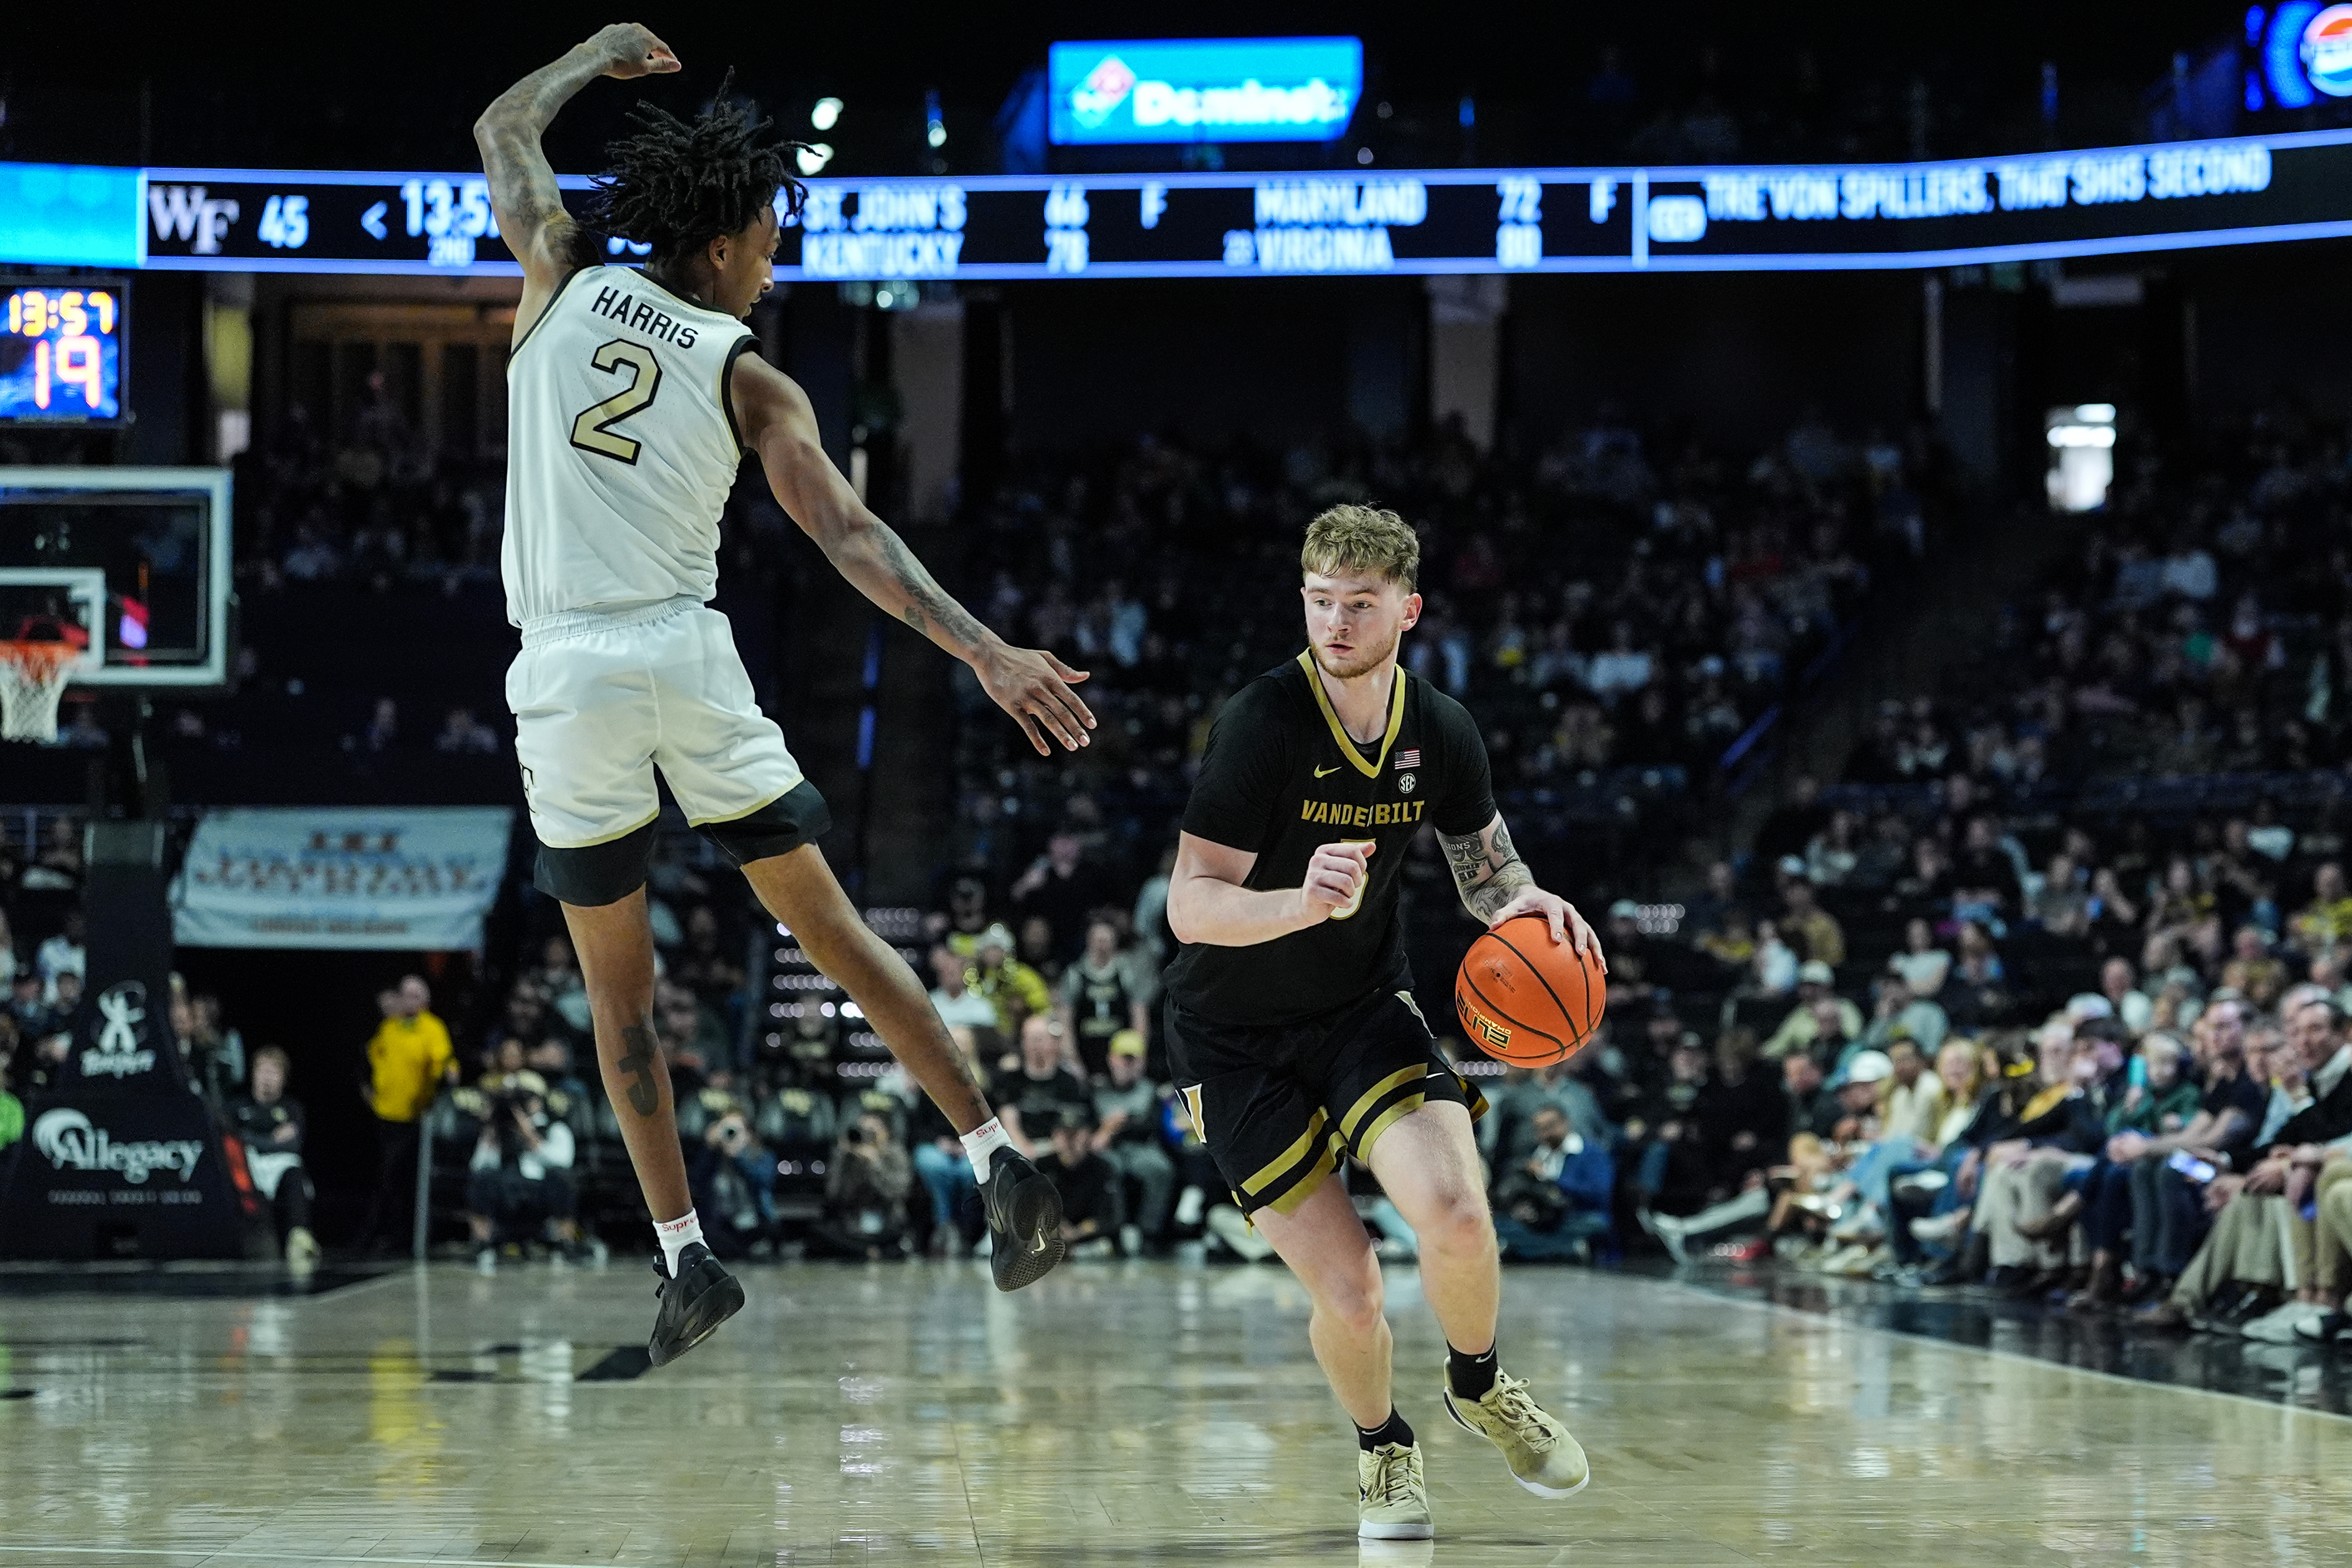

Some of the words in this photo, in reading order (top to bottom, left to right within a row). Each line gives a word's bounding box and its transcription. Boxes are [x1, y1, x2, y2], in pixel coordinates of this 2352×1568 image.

[2148, 144, 2271, 200] SECOND
[258, 195, 309, 249] 45
[1141, 181, 1168, 229] F
[1254, 179, 1427, 226] MARYLAND
[1590, 177, 1618, 223] F
[802, 232, 964, 276] KENTUCKY
[1255, 226, 1394, 271] VIRGINIA
[9, 291, 113, 337] 13:57
[591, 286, 699, 349] HARRIS
[35, 335, 101, 410] 19
[570, 338, 663, 466] 2
[1400, 775, 1416, 792] SEC
[1456, 989, 1510, 1050] ELITE
[51, 1128, 203, 1183] Allegacy
